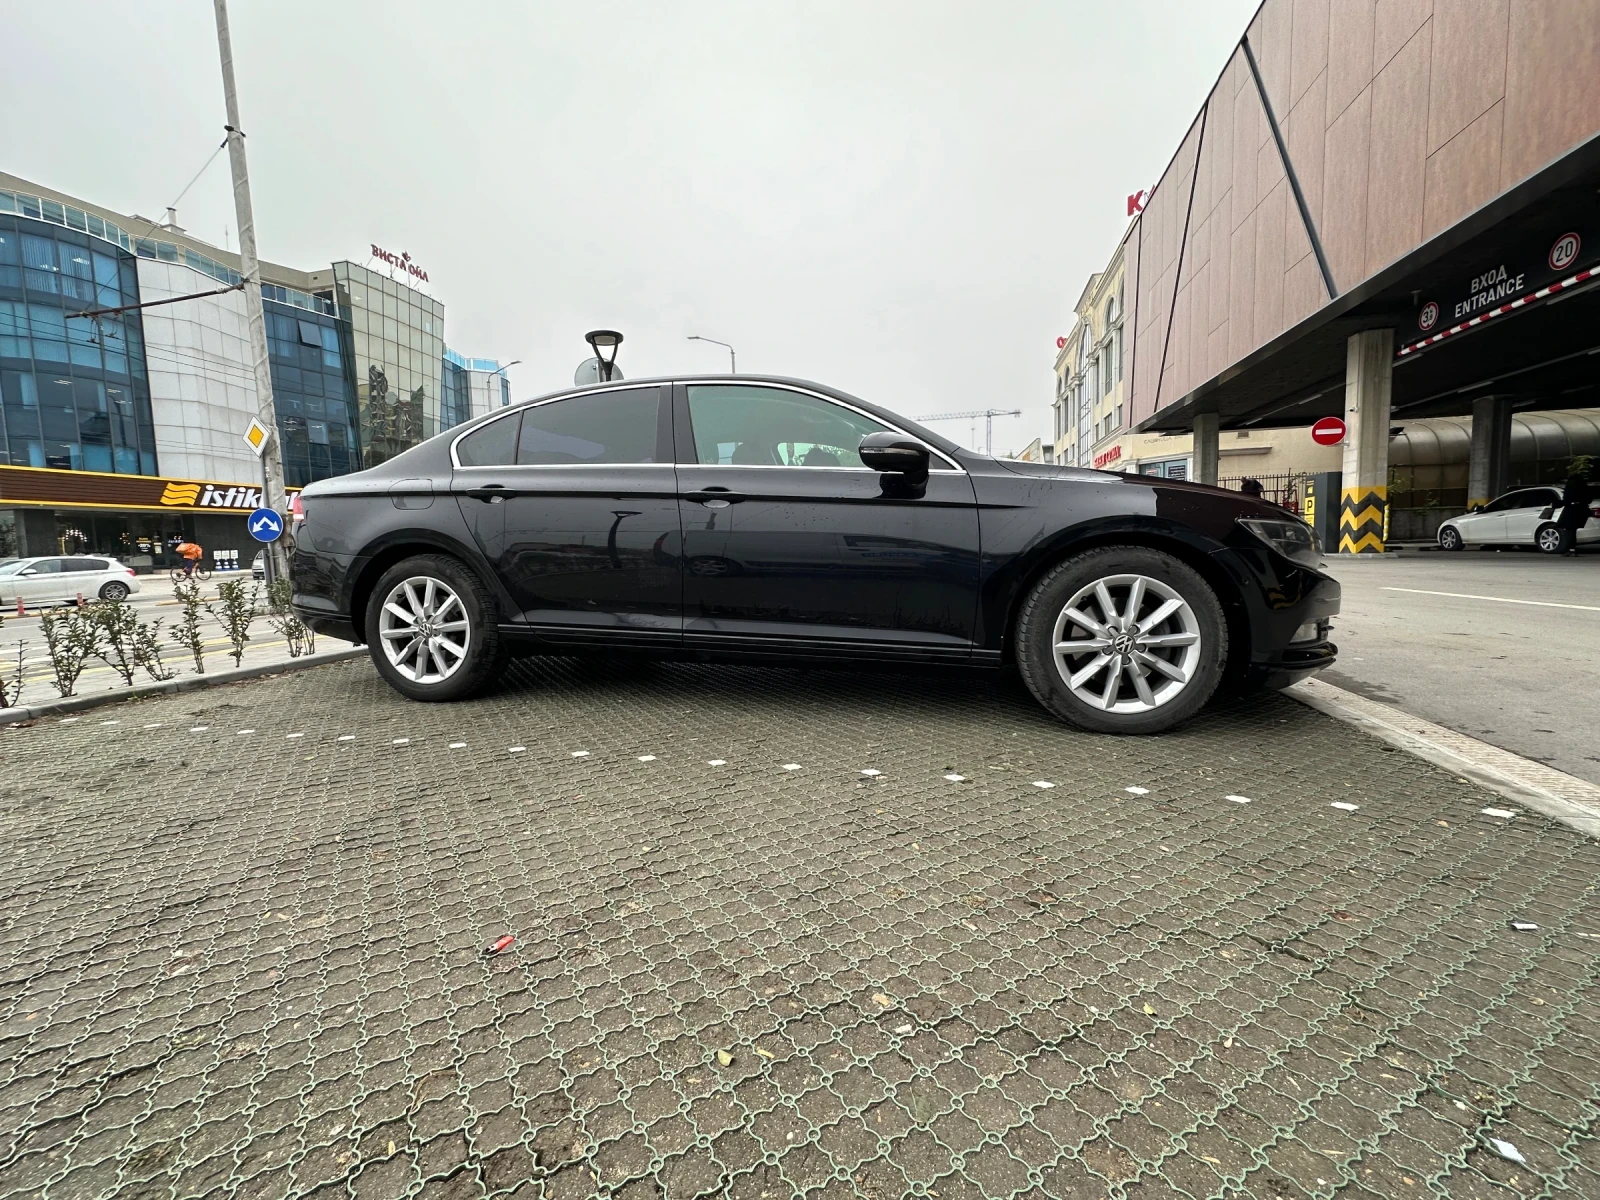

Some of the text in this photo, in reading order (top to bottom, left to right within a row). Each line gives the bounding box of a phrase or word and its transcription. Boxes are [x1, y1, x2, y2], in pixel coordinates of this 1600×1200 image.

[370, 244, 407, 272] ВИСТА
[1555, 241, 1573, 263] 20
[1471, 265, 1507, 294] ВХОД
[1455, 273, 1525, 318] ENTRANCE
[200, 484, 300, 510] istikl
[1306, 500, 1314, 513] P
